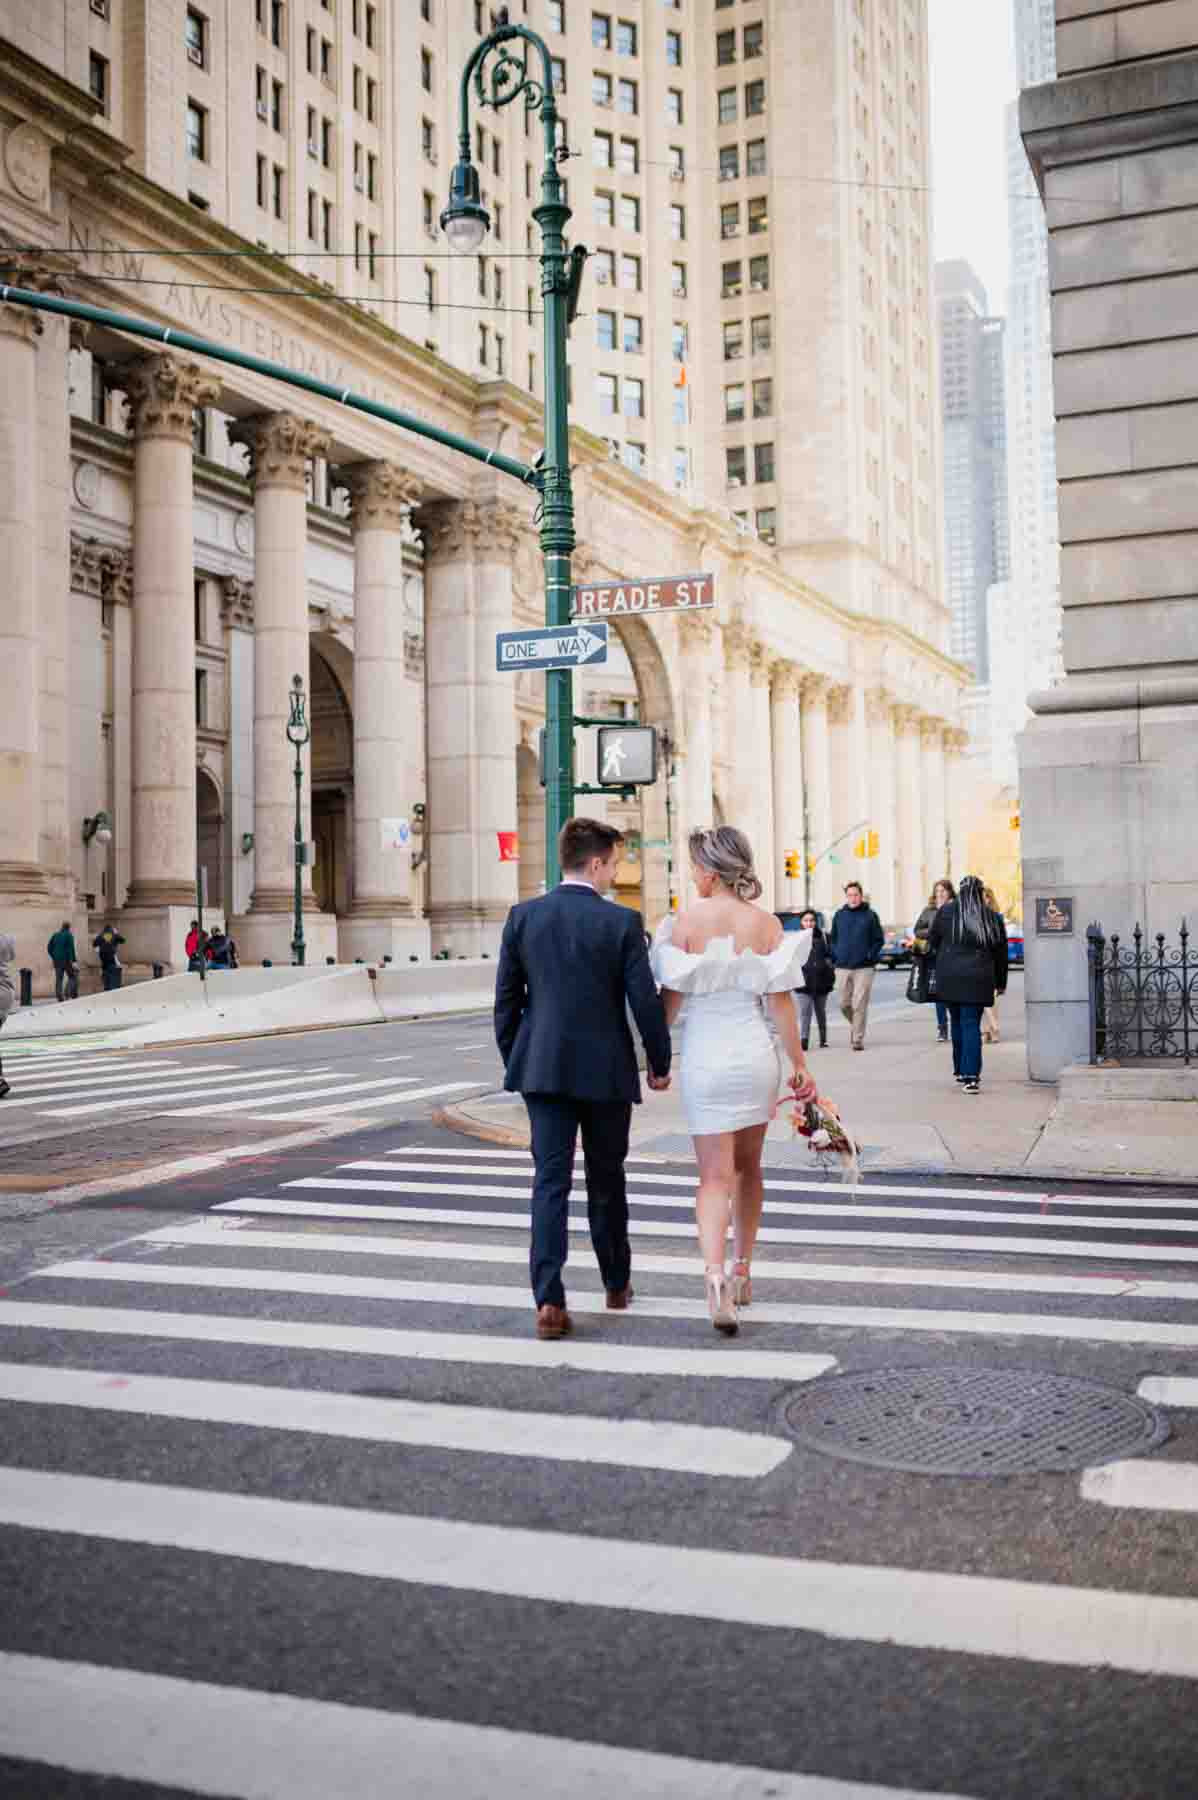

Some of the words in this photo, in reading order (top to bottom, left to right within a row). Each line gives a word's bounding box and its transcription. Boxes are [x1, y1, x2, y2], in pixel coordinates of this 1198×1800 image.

[68, 215, 145, 279] NEW
[162, 278, 350, 384] AMSTERDAM
[582, 585, 661, 614] READE
[676, 581, 707, 606] ST
[505, 642, 538, 660] ONE
[556, 637, 592, 655] WAY
